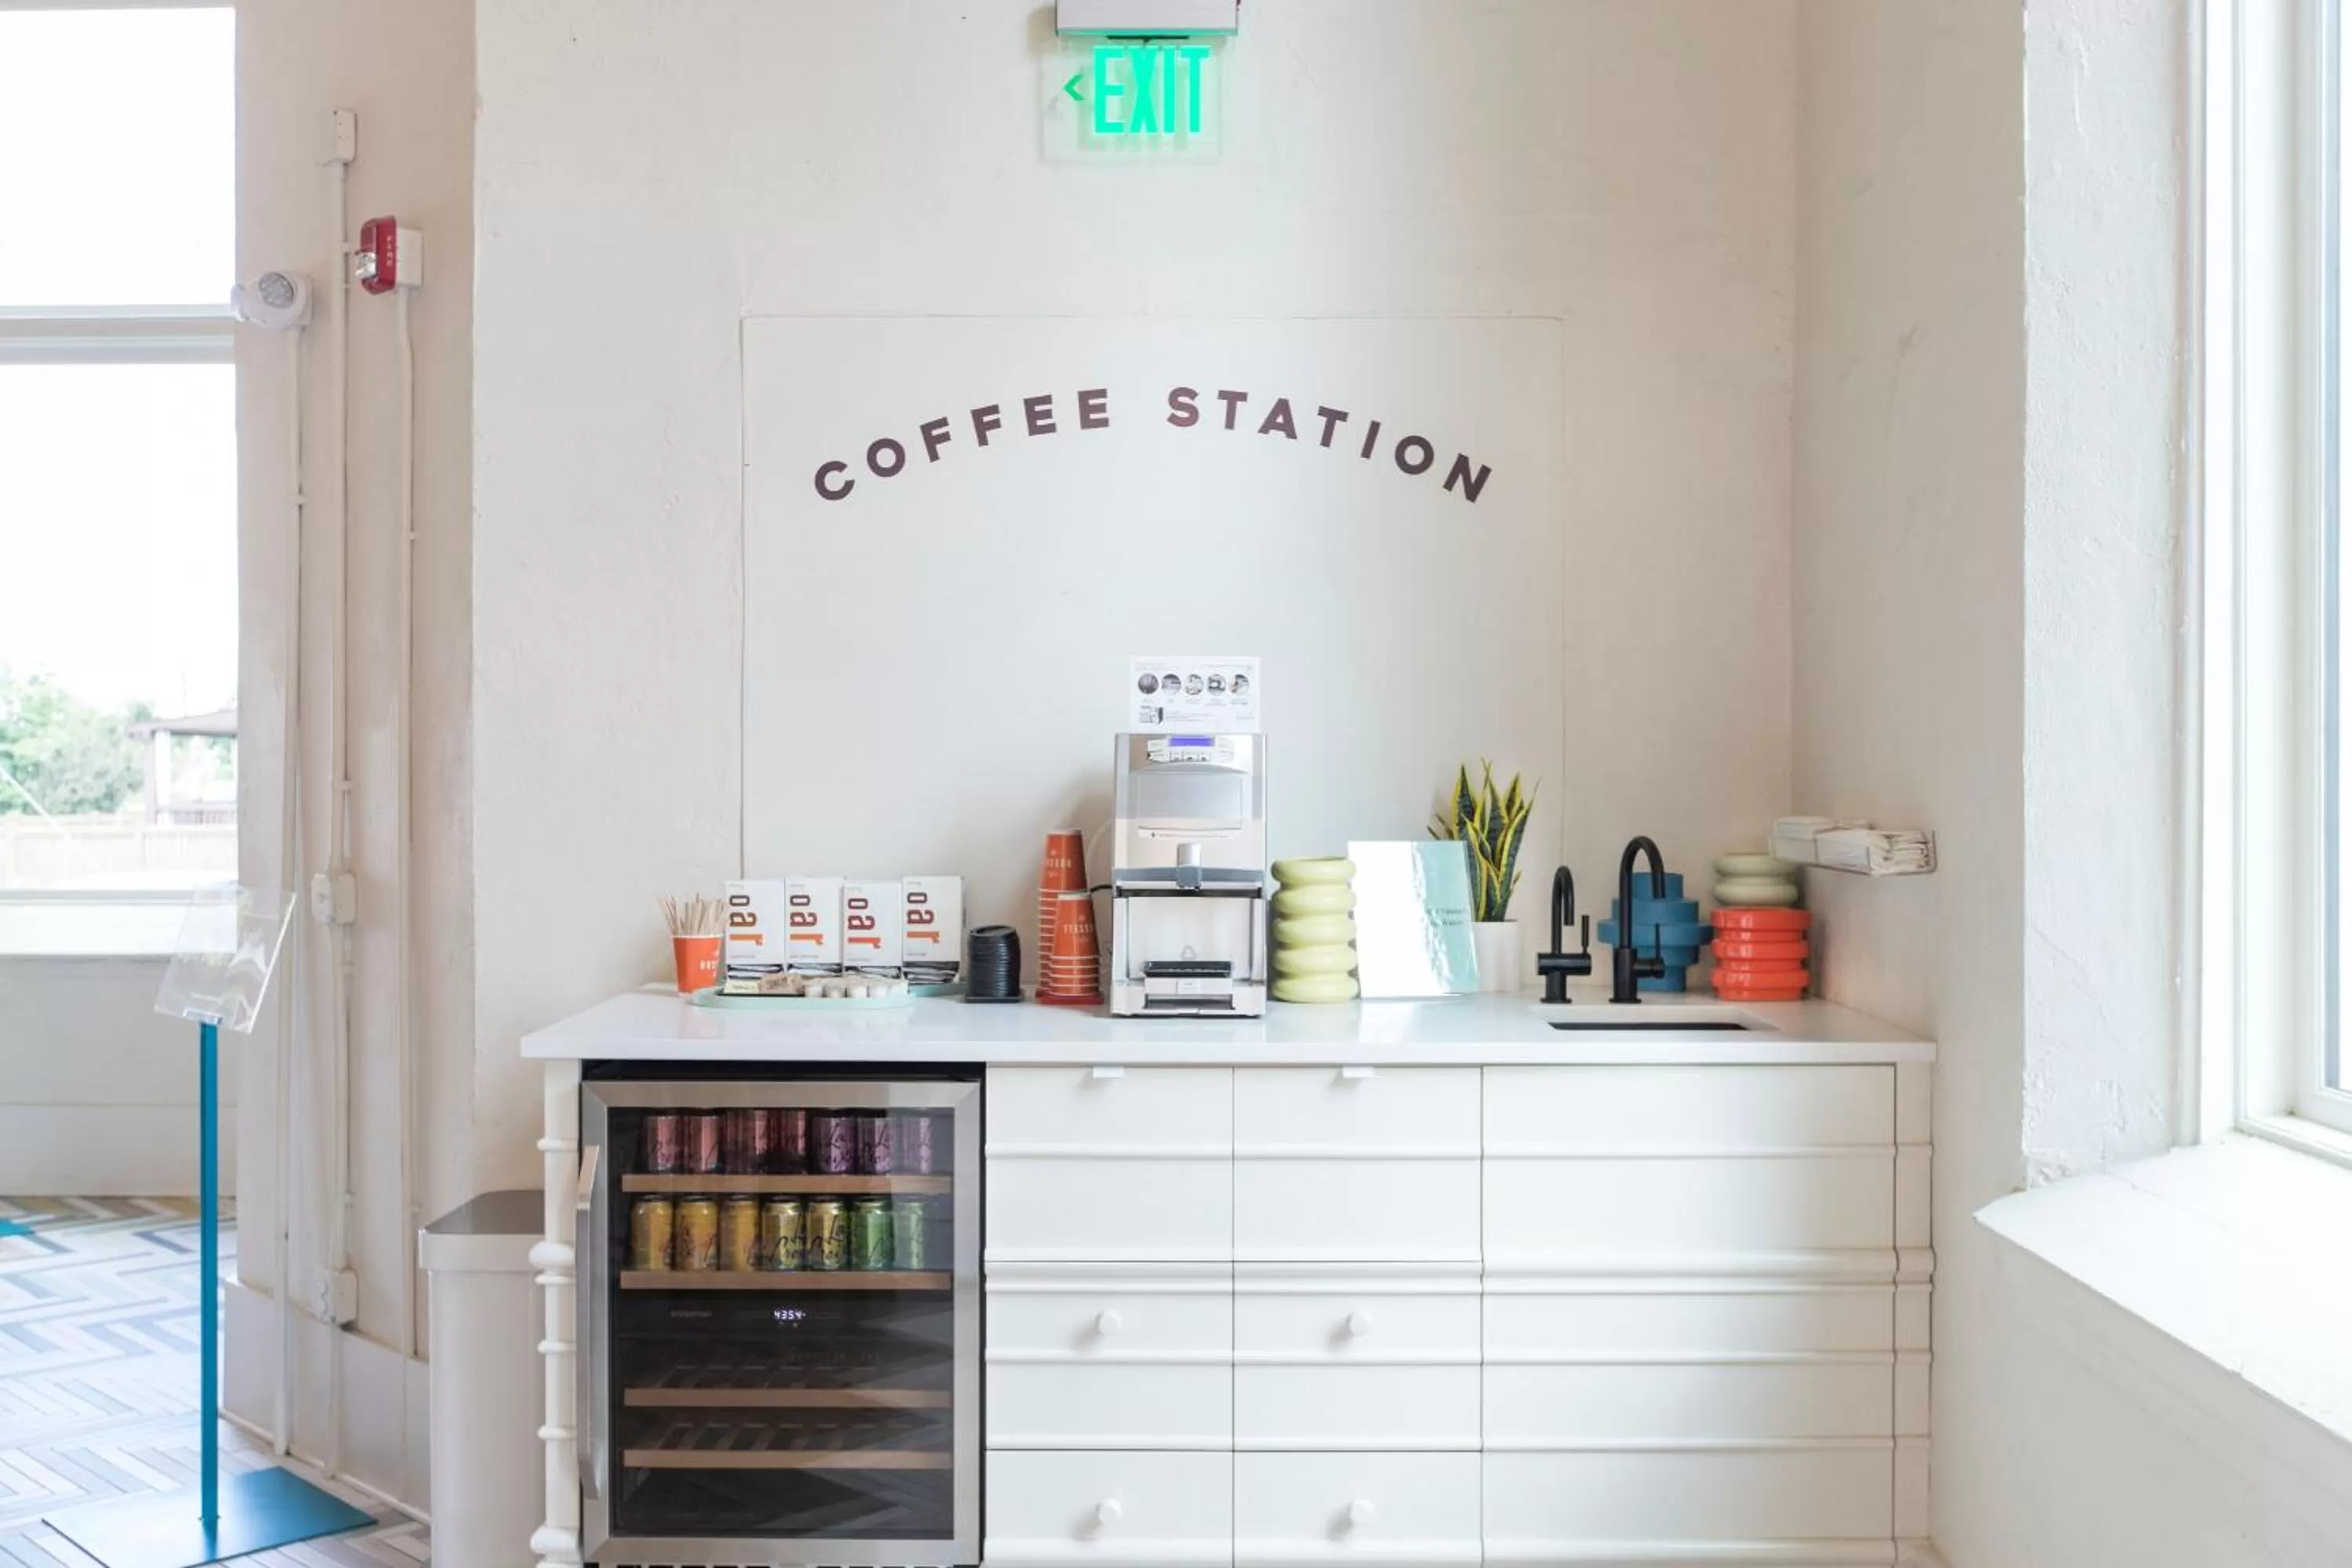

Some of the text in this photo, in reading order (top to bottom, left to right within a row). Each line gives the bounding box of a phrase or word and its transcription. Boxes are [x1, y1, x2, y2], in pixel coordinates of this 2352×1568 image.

[1094, 45, 1210, 134] EXIT
[814, 387, 1493, 503] COFFEE STATION
